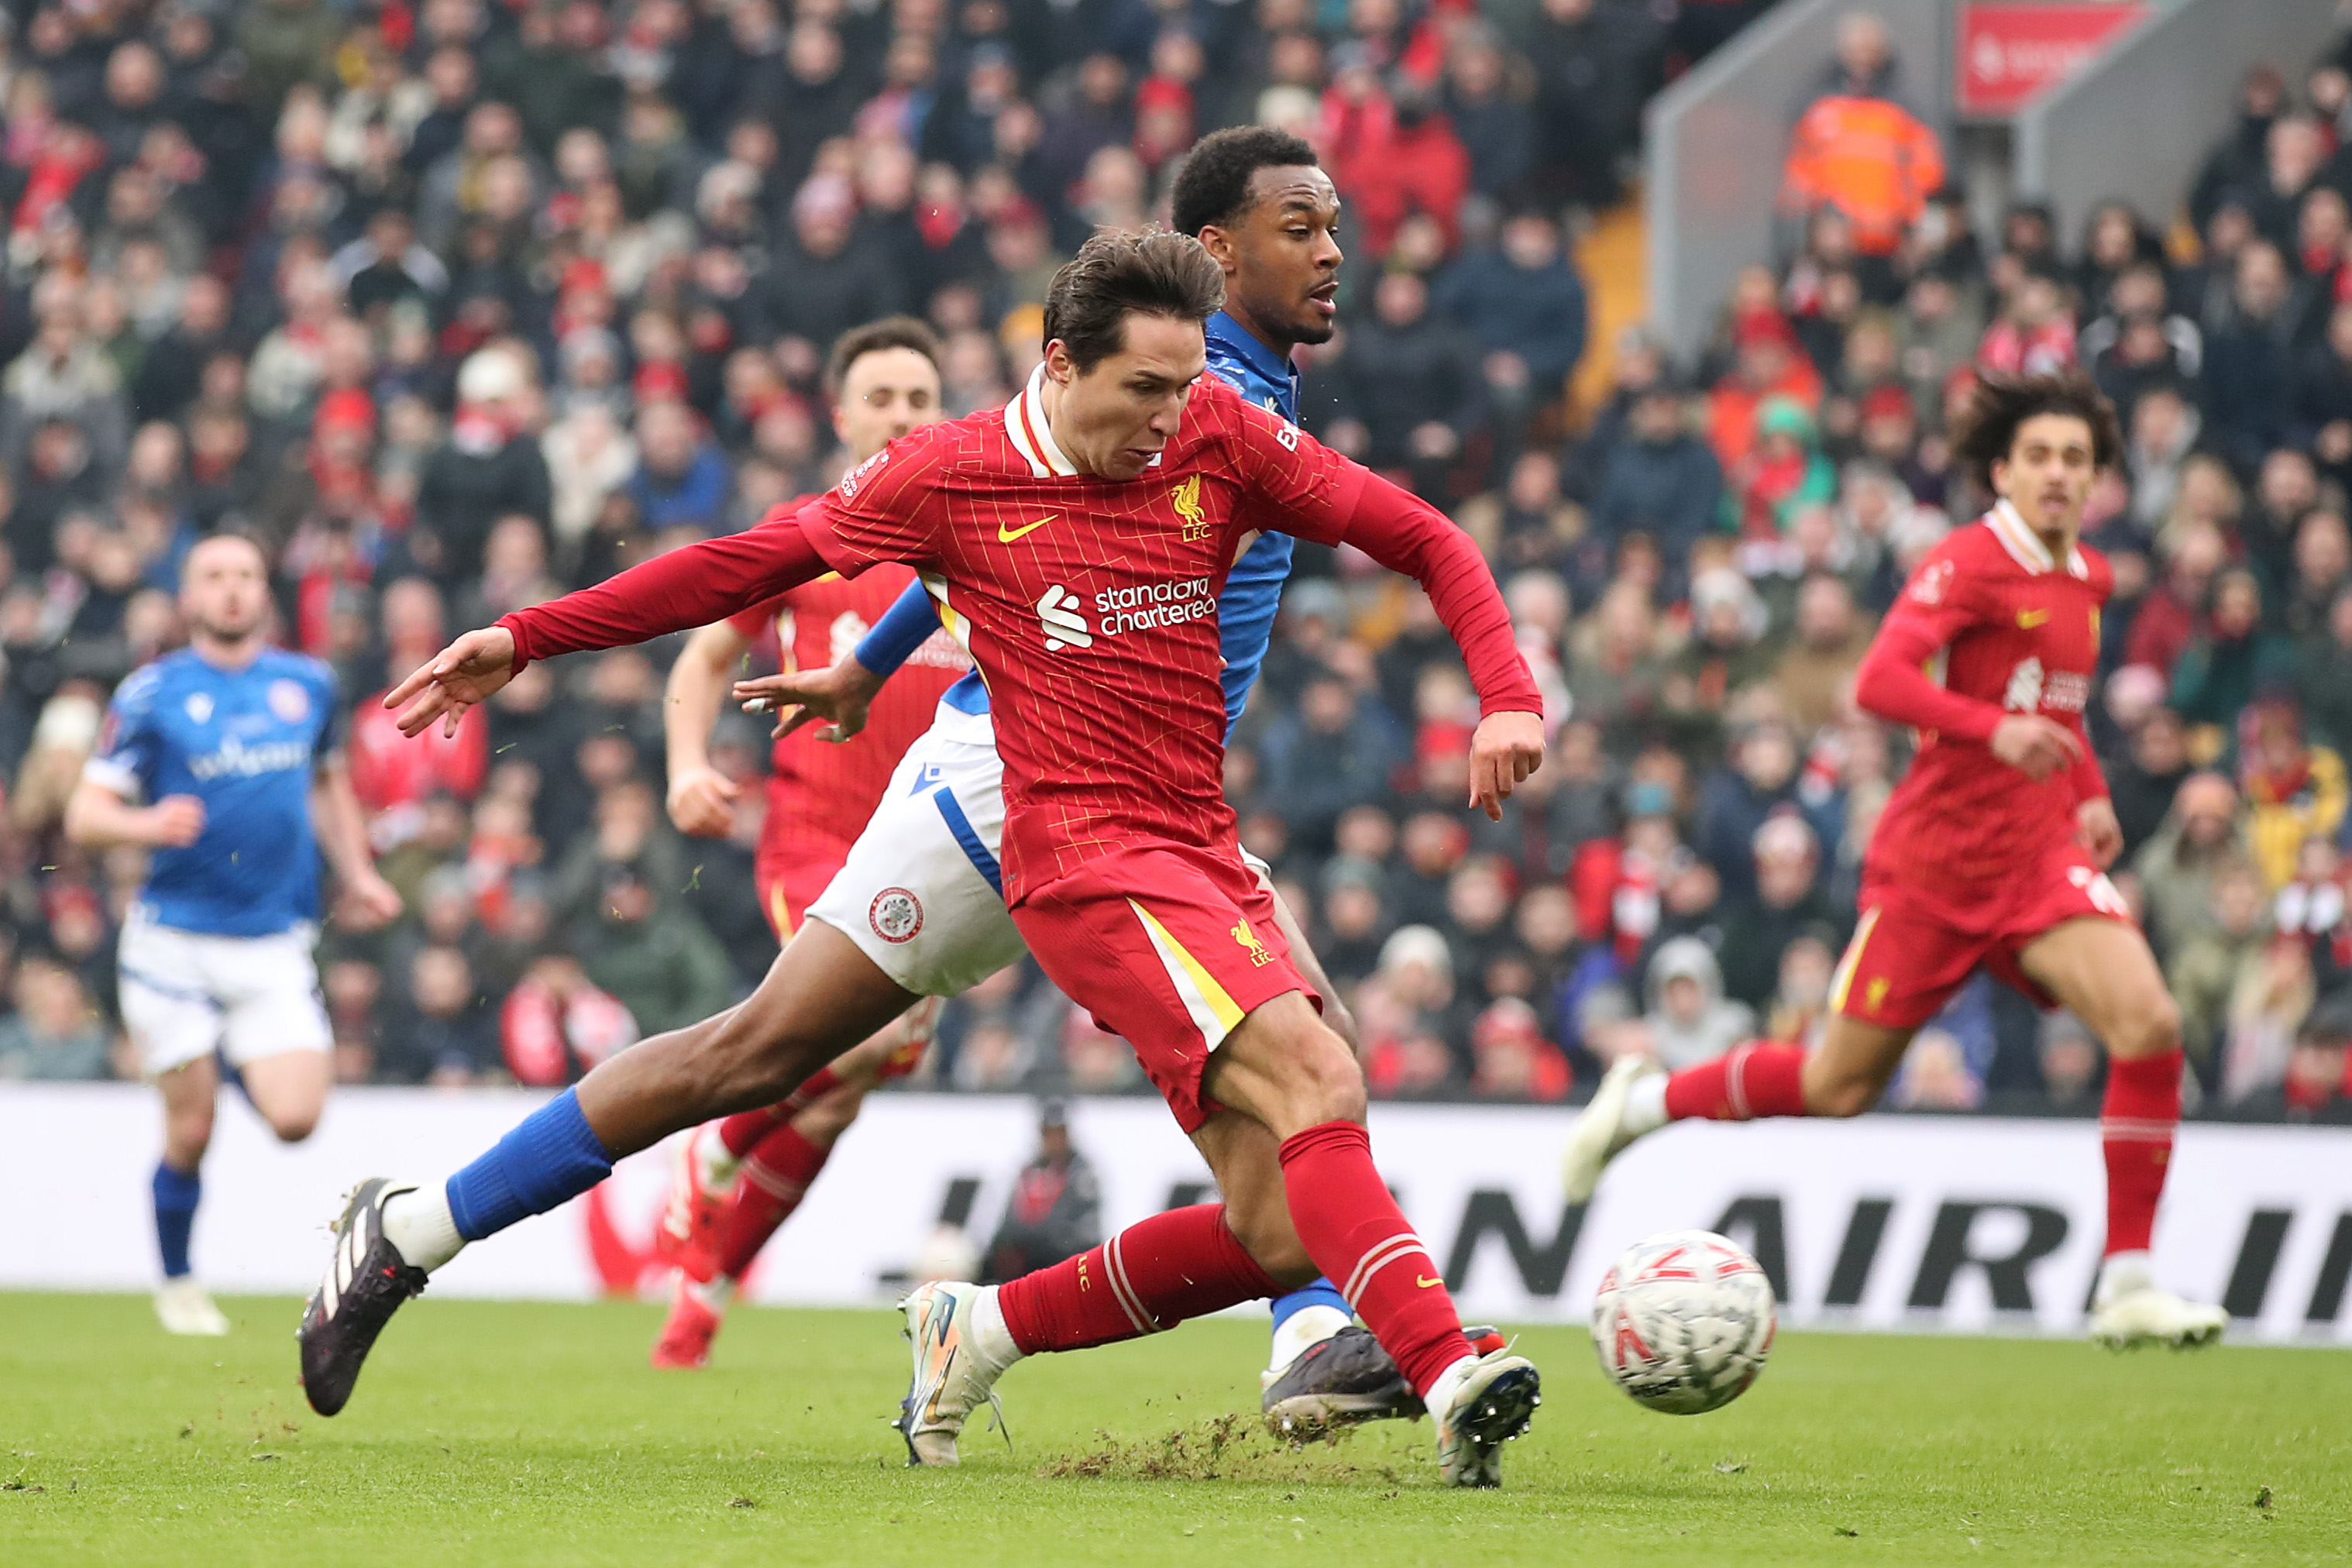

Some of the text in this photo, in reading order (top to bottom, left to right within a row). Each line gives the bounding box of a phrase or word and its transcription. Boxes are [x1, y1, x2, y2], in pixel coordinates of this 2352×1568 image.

[1095, 576, 1212, 613] standard
[1100, 593, 1217, 636] chartered
[1709, 1197, 2352, 1321] AIRI
